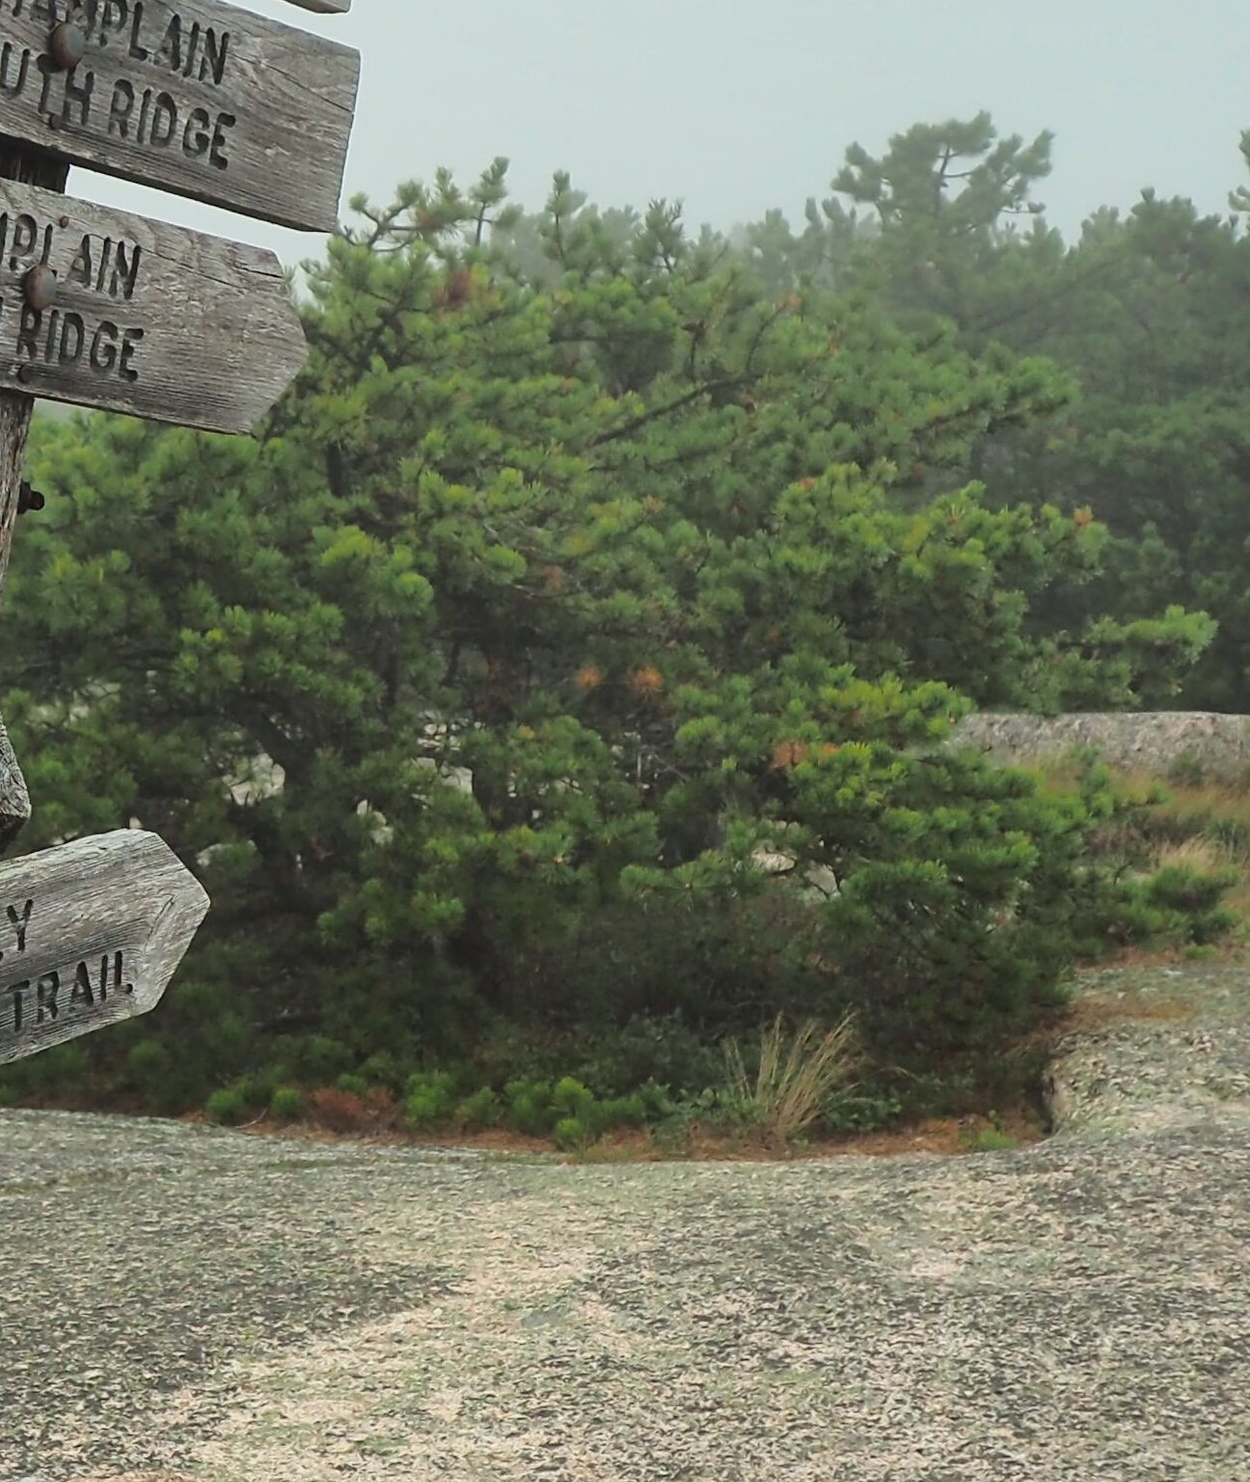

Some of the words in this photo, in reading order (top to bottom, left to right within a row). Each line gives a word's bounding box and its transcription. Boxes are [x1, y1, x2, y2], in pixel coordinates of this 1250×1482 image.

[107, 78, 237, 170] RIDGE
[16, 301, 145, 383] RIDGE
[6, 949, 134, 1032] TRAIL
